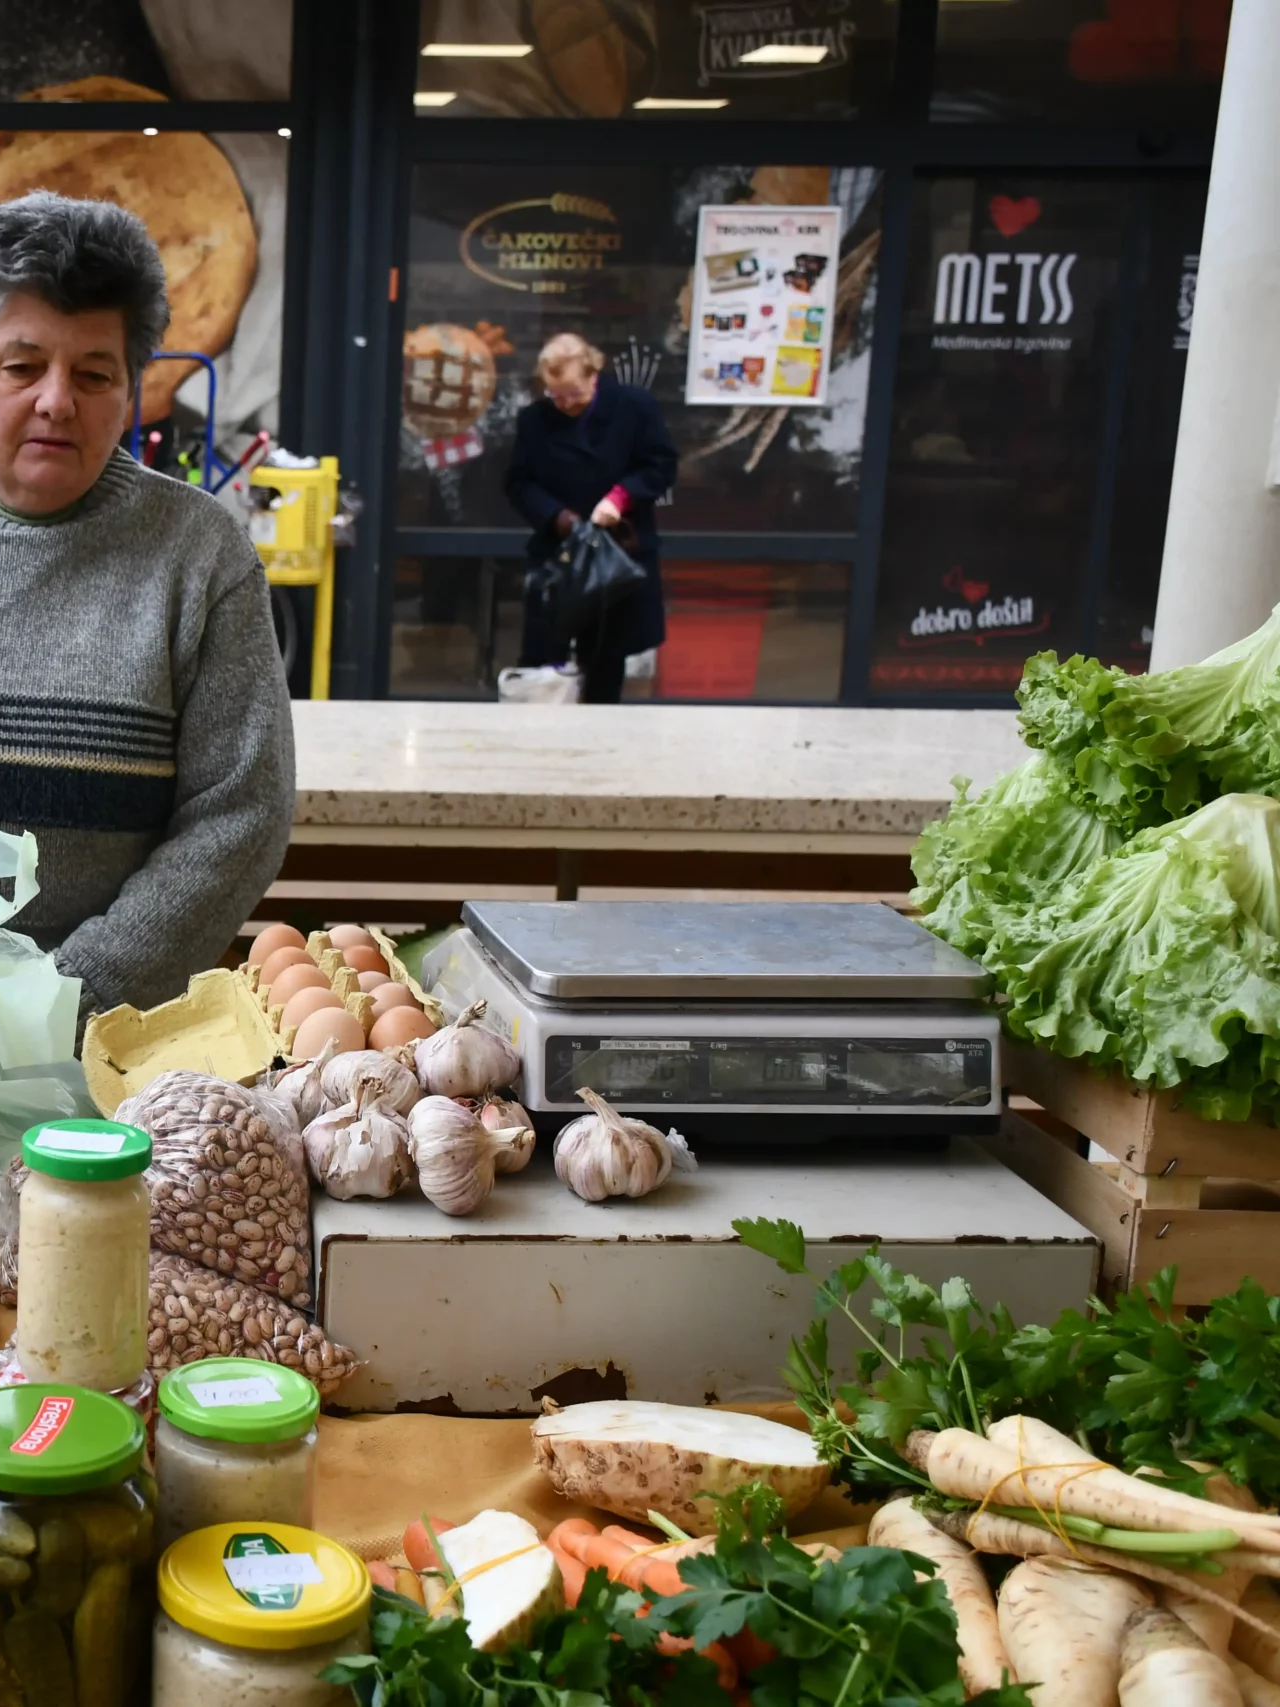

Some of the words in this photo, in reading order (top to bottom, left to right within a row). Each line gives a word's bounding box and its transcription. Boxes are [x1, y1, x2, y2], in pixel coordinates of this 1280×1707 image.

[481, 228, 622, 250] ČAKOVEČKI
[497, 252, 605, 270] MLINOVI
[933, 253, 1077, 325] METSS
[910, 605, 972, 636] dobro
[571, 1041, 582, 1049] kg
[19, 1400, 68, 1451] Freshona
